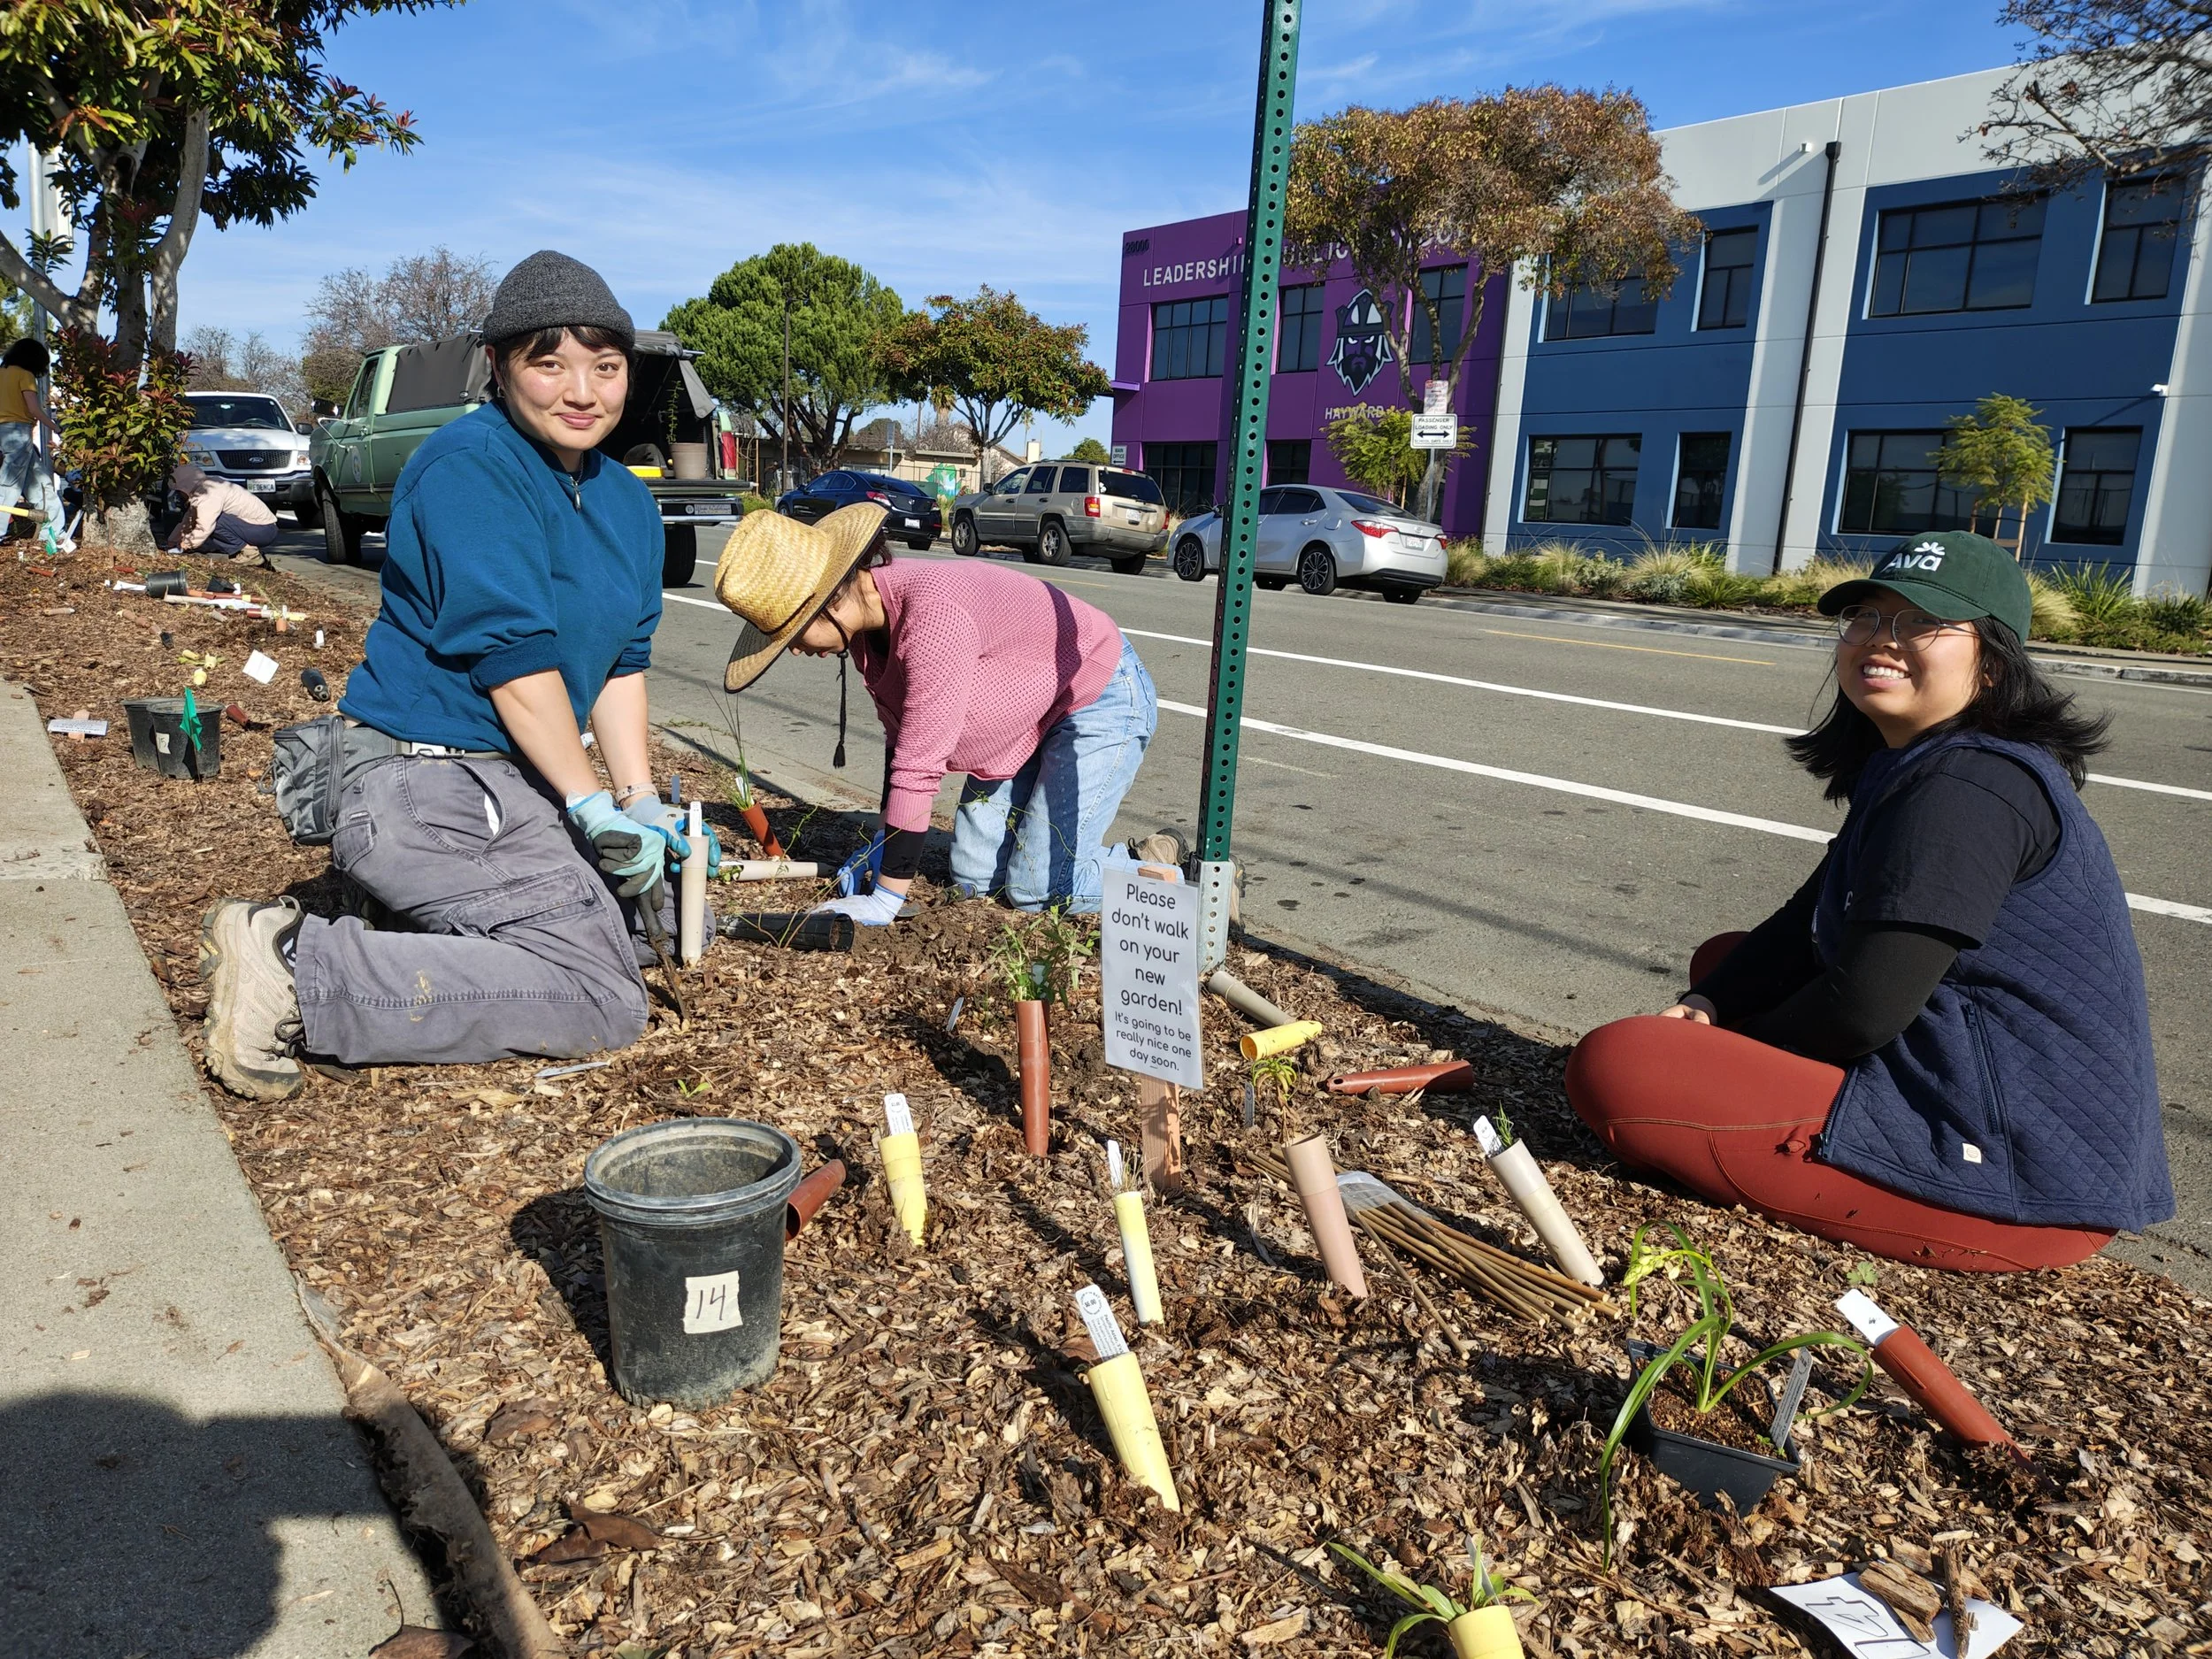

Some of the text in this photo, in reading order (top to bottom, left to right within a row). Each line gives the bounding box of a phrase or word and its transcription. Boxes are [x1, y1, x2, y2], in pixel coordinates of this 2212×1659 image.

[1880, 553, 1943, 572] Ava
[1126, 883, 1176, 910] Please
[1111, 908, 1188, 940] don't walk
[1119, 939, 1179, 964] on your
[1135, 967, 1165, 986] new
[1120, 989, 1182, 1016] garden!
[1115, 1010, 1192, 1041] It's going to be
[1116, 1029, 1192, 1058] really nice one
[1129, 1048, 1179, 1071] day soon.
[695, 1283, 726, 1321] 14
